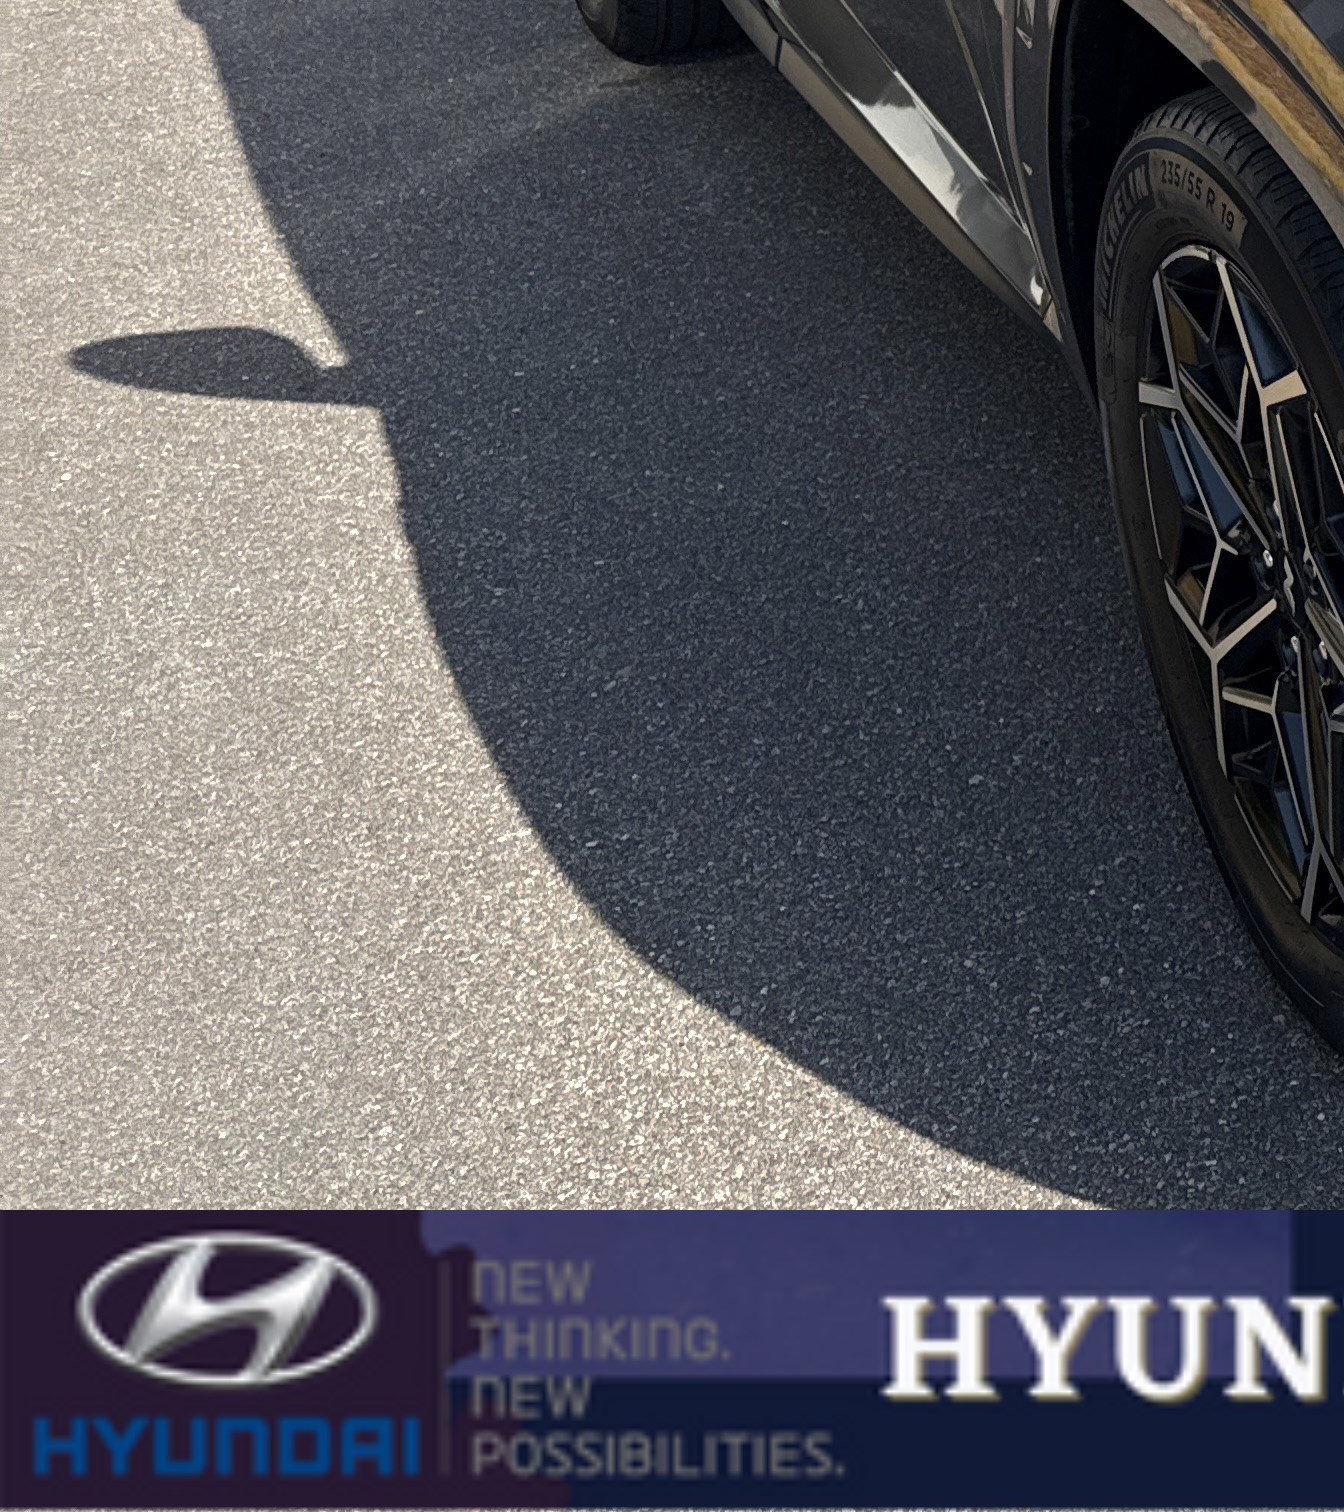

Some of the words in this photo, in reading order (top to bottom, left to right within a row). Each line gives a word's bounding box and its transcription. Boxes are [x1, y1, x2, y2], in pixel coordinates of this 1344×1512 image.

[1159, 158, 1204, 201] 235/55
[1205, 186, 1217, 213] R
[1220, 202, 1236, 233] 19
